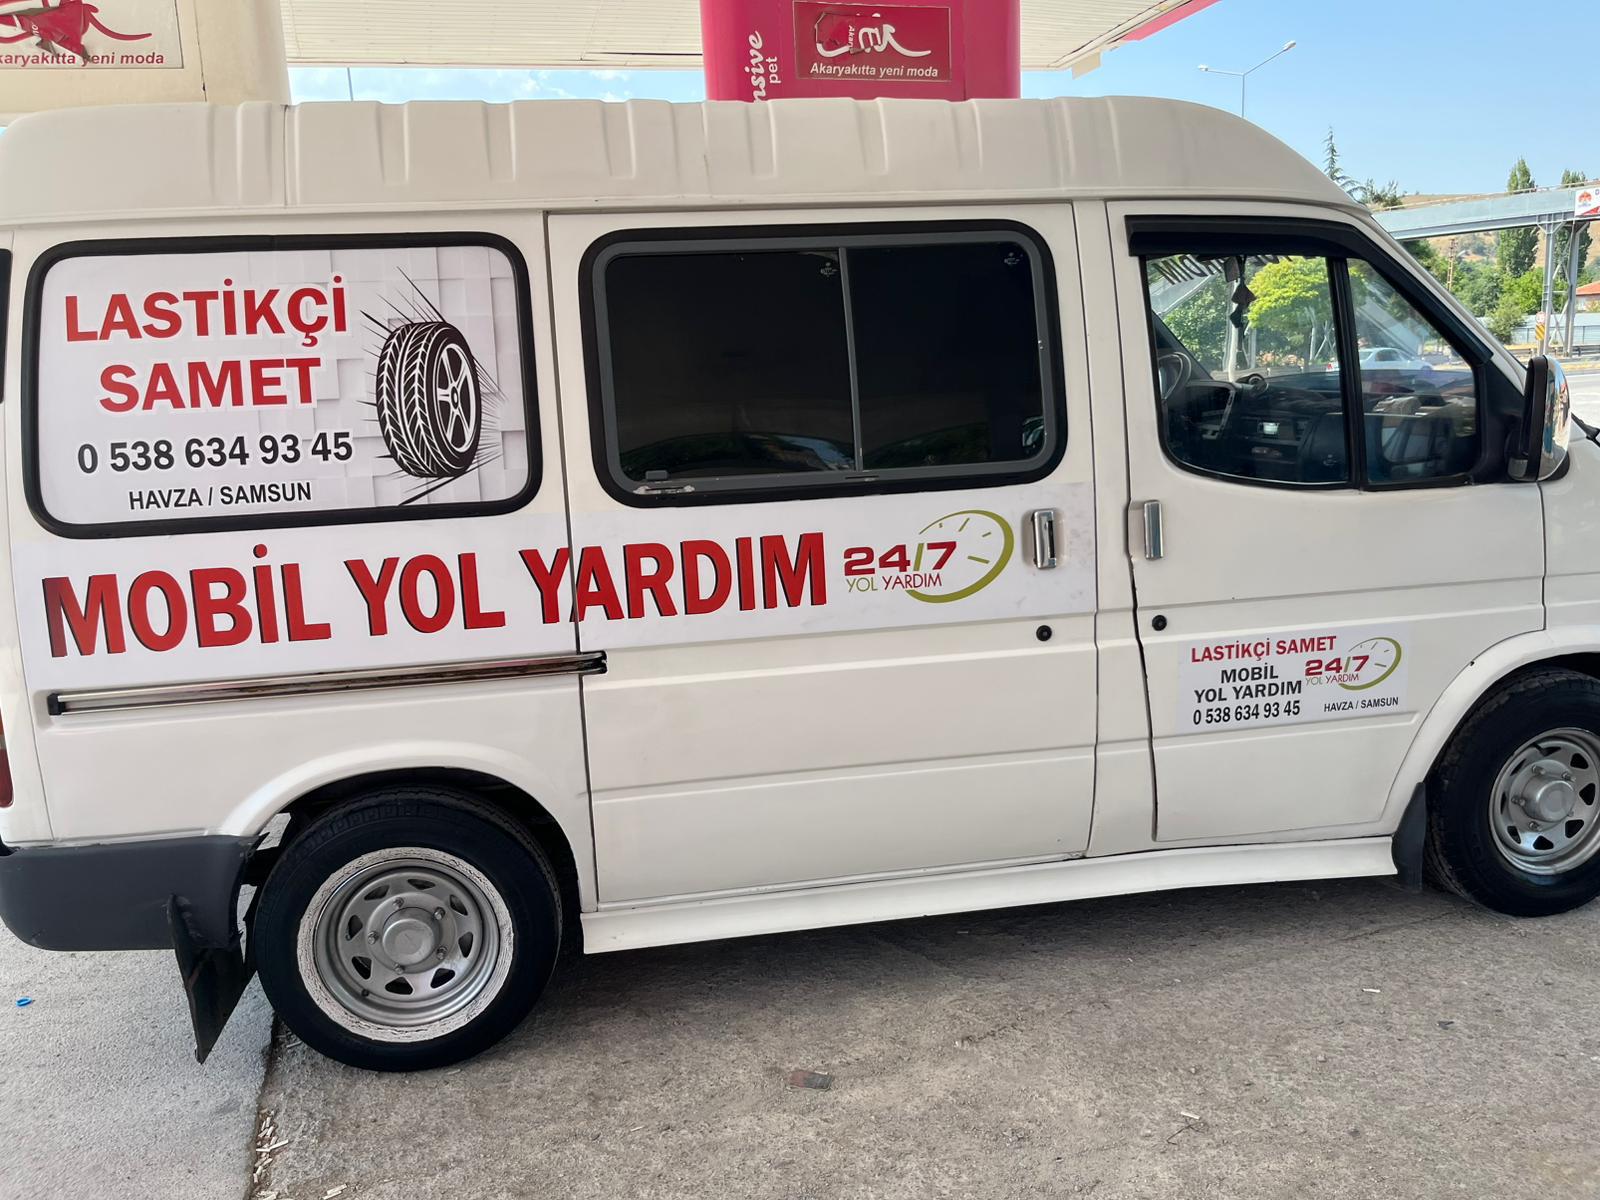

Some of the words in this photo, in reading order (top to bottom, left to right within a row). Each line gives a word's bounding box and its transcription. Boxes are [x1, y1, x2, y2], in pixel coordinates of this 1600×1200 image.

[0, 53, 76, 67] aryakıtta
[82, 52, 115, 67] yeni
[120, 52, 164, 64] moda
[766, 56, 781, 84] pet
[810, 62, 876, 77] Akaryakıtta
[879, 66, 904, 78] yeni
[906, 66, 938, 77] moda
[65, 275, 348, 347] LASTİKÇİ
[99, 357, 321, 414] SAMET
[77, 443, 99, 474] 0
[109, 439, 175, 472] 538
[185, 435, 250, 467] 634
[260, 432, 301, 465] 93
[311, 431, 353, 462] 45
[129, 487, 203, 510] HAVZA
[219, 482, 312, 506] SAMSUN
[843, 541, 957, 576] 24/7
[42, 544, 332, 658] MOBİL
[345, 552, 506, 637] YOL
[518, 532, 827, 624] YARDIM
[846, 577, 878, 593] YOL
[882, 573, 942, 591] YARDIM
[1191, 638, 1271, 662] LASTİKÇİ
[1276, 635, 1337, 654] SAMET
[1220, 662, 1279, 684] MOBİL
[1305, 655, 1370, 677] 24/7
[1194, 688, 1228, 704] YOL
[1232, 680, 1302, 700] YARDIM
[1305, 676, 1323, 686] YOL
[1325, 673, 1360, 684] YARDIM
[1193, 709, 1202, 725] 0
[1205, 706, 1231, 724] 538
[1234, 703, 1260, 721] 634
[1263, 701, 1280, 719] 93
[1283, 700, 1301, 717] 45
[1323, 701, 1354, 713] HAVZA
[1360, 697, 1399, 709] SAMSUN
